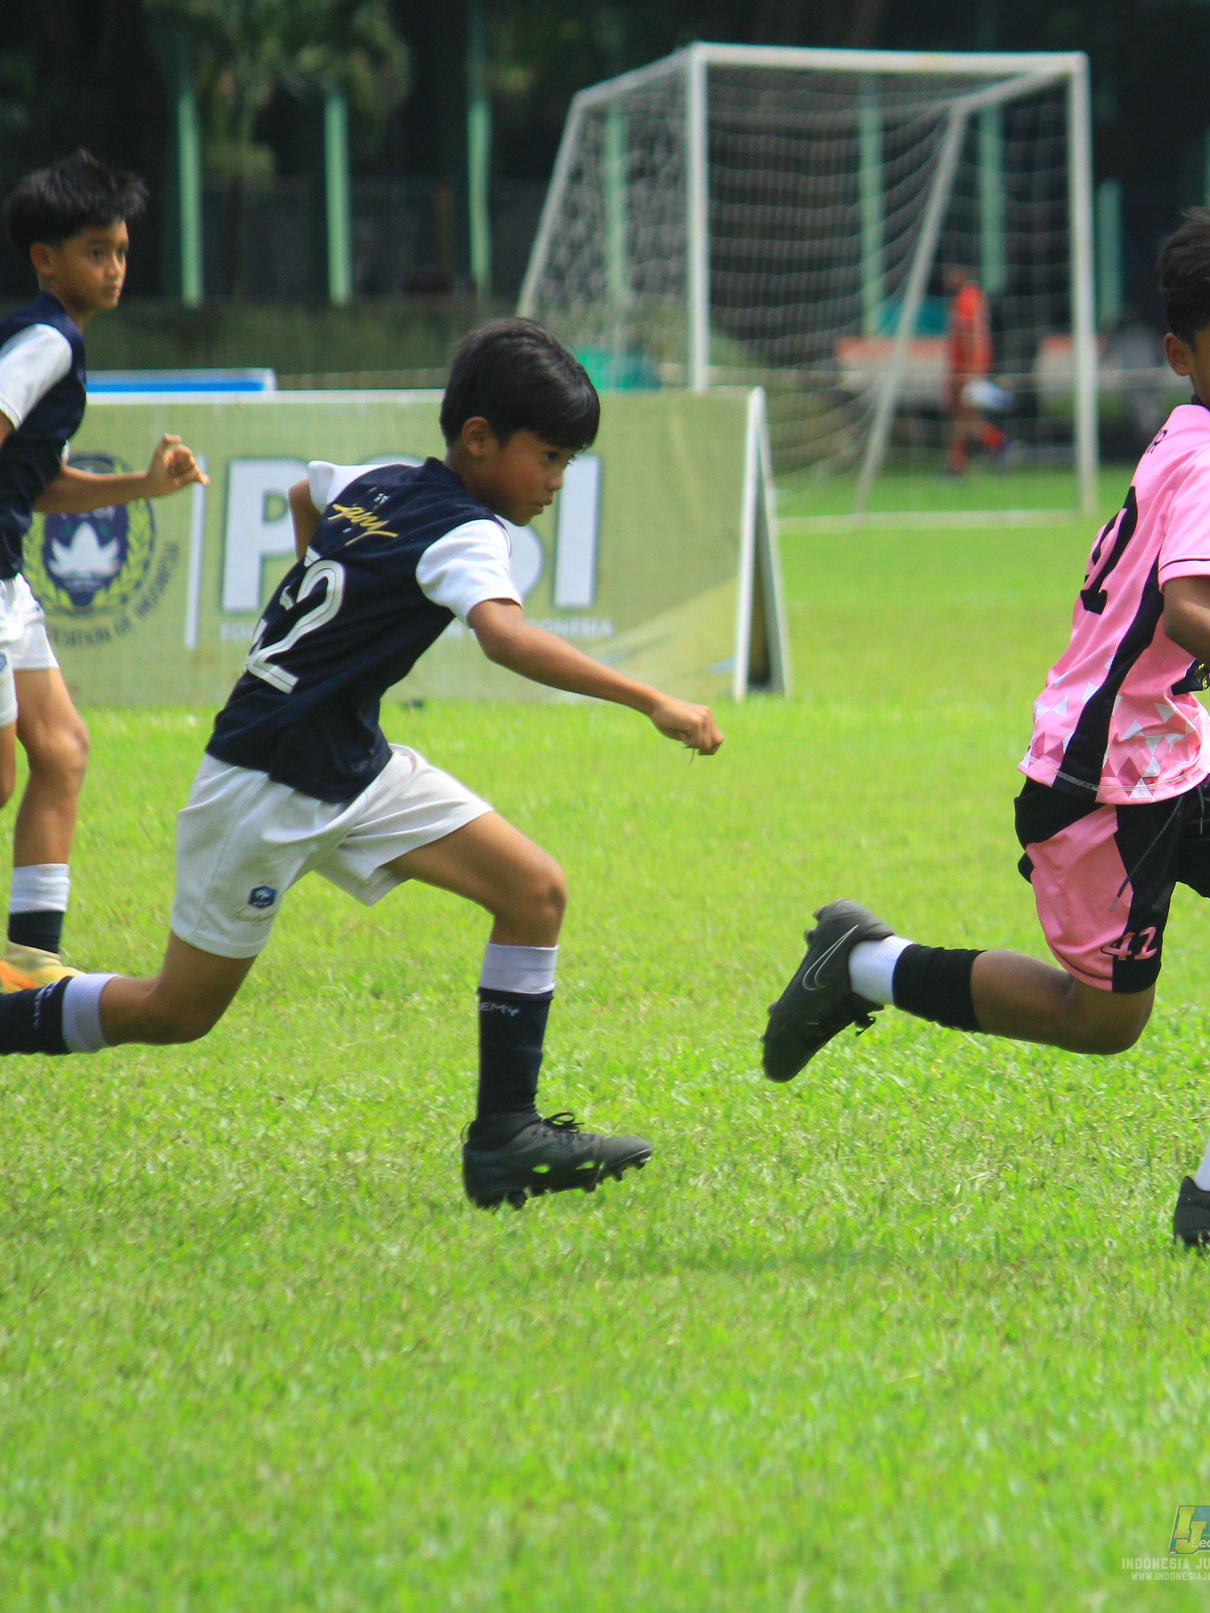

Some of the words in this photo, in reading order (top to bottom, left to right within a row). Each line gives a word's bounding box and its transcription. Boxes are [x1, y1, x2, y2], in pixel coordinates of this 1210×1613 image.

[222, 455, 599, 615] PI
[246, 546, 346, 693] 2
[1102, 926, 1158, 961] 42
